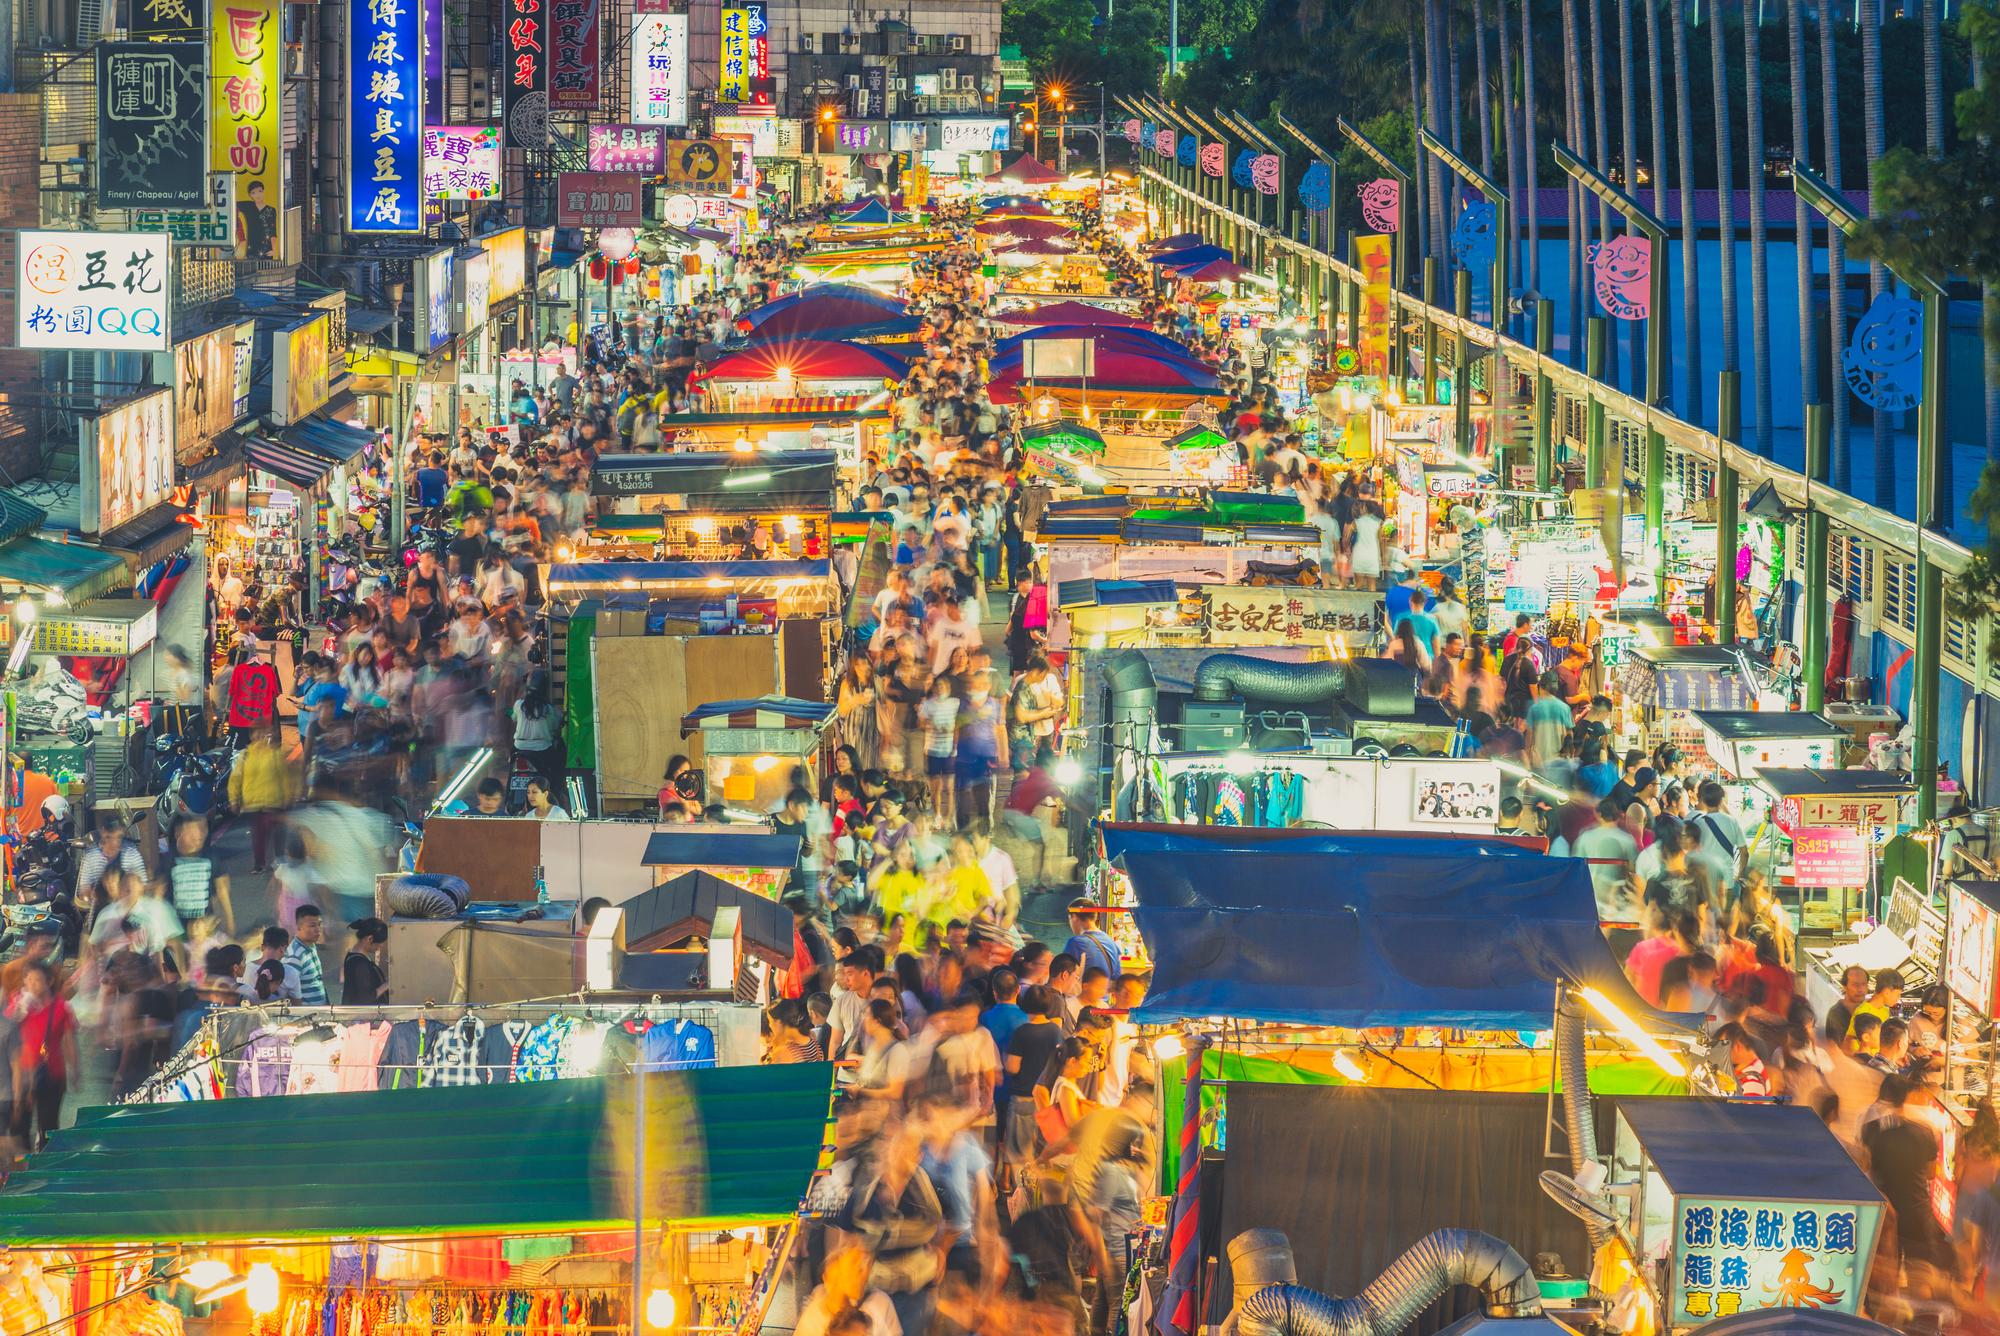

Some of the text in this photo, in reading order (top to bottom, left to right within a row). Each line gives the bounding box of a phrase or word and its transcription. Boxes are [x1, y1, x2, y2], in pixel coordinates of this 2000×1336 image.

[725, 12, 744, 102] 建信棉被
[225, 7, 266, 172] 匠飾品
[600, 129, 658, 150] 水晶球
[107, 191, 131, 200] Finery
[136, 190, 173, 200] Chapeau
[178, 190, 199, 199] Aglet
[135, 211, 228, 241] 保護貼
[1364, 207, 1397, 232] CHUNGLI
[1597, 281, 1646, 318] CHUNGLI
[1213, 602, 1286, 632] 吉安尼
[1286, 599, 1303, 640] 拖鞋
[1796, 836, 1829, 854] S925
[1683, 1206, 1857, 1254] 深海魷魚頭
[1682, 1252, 1750, 1290] 龍珠
[1685, 1290, 1742, 1318] 專賣
